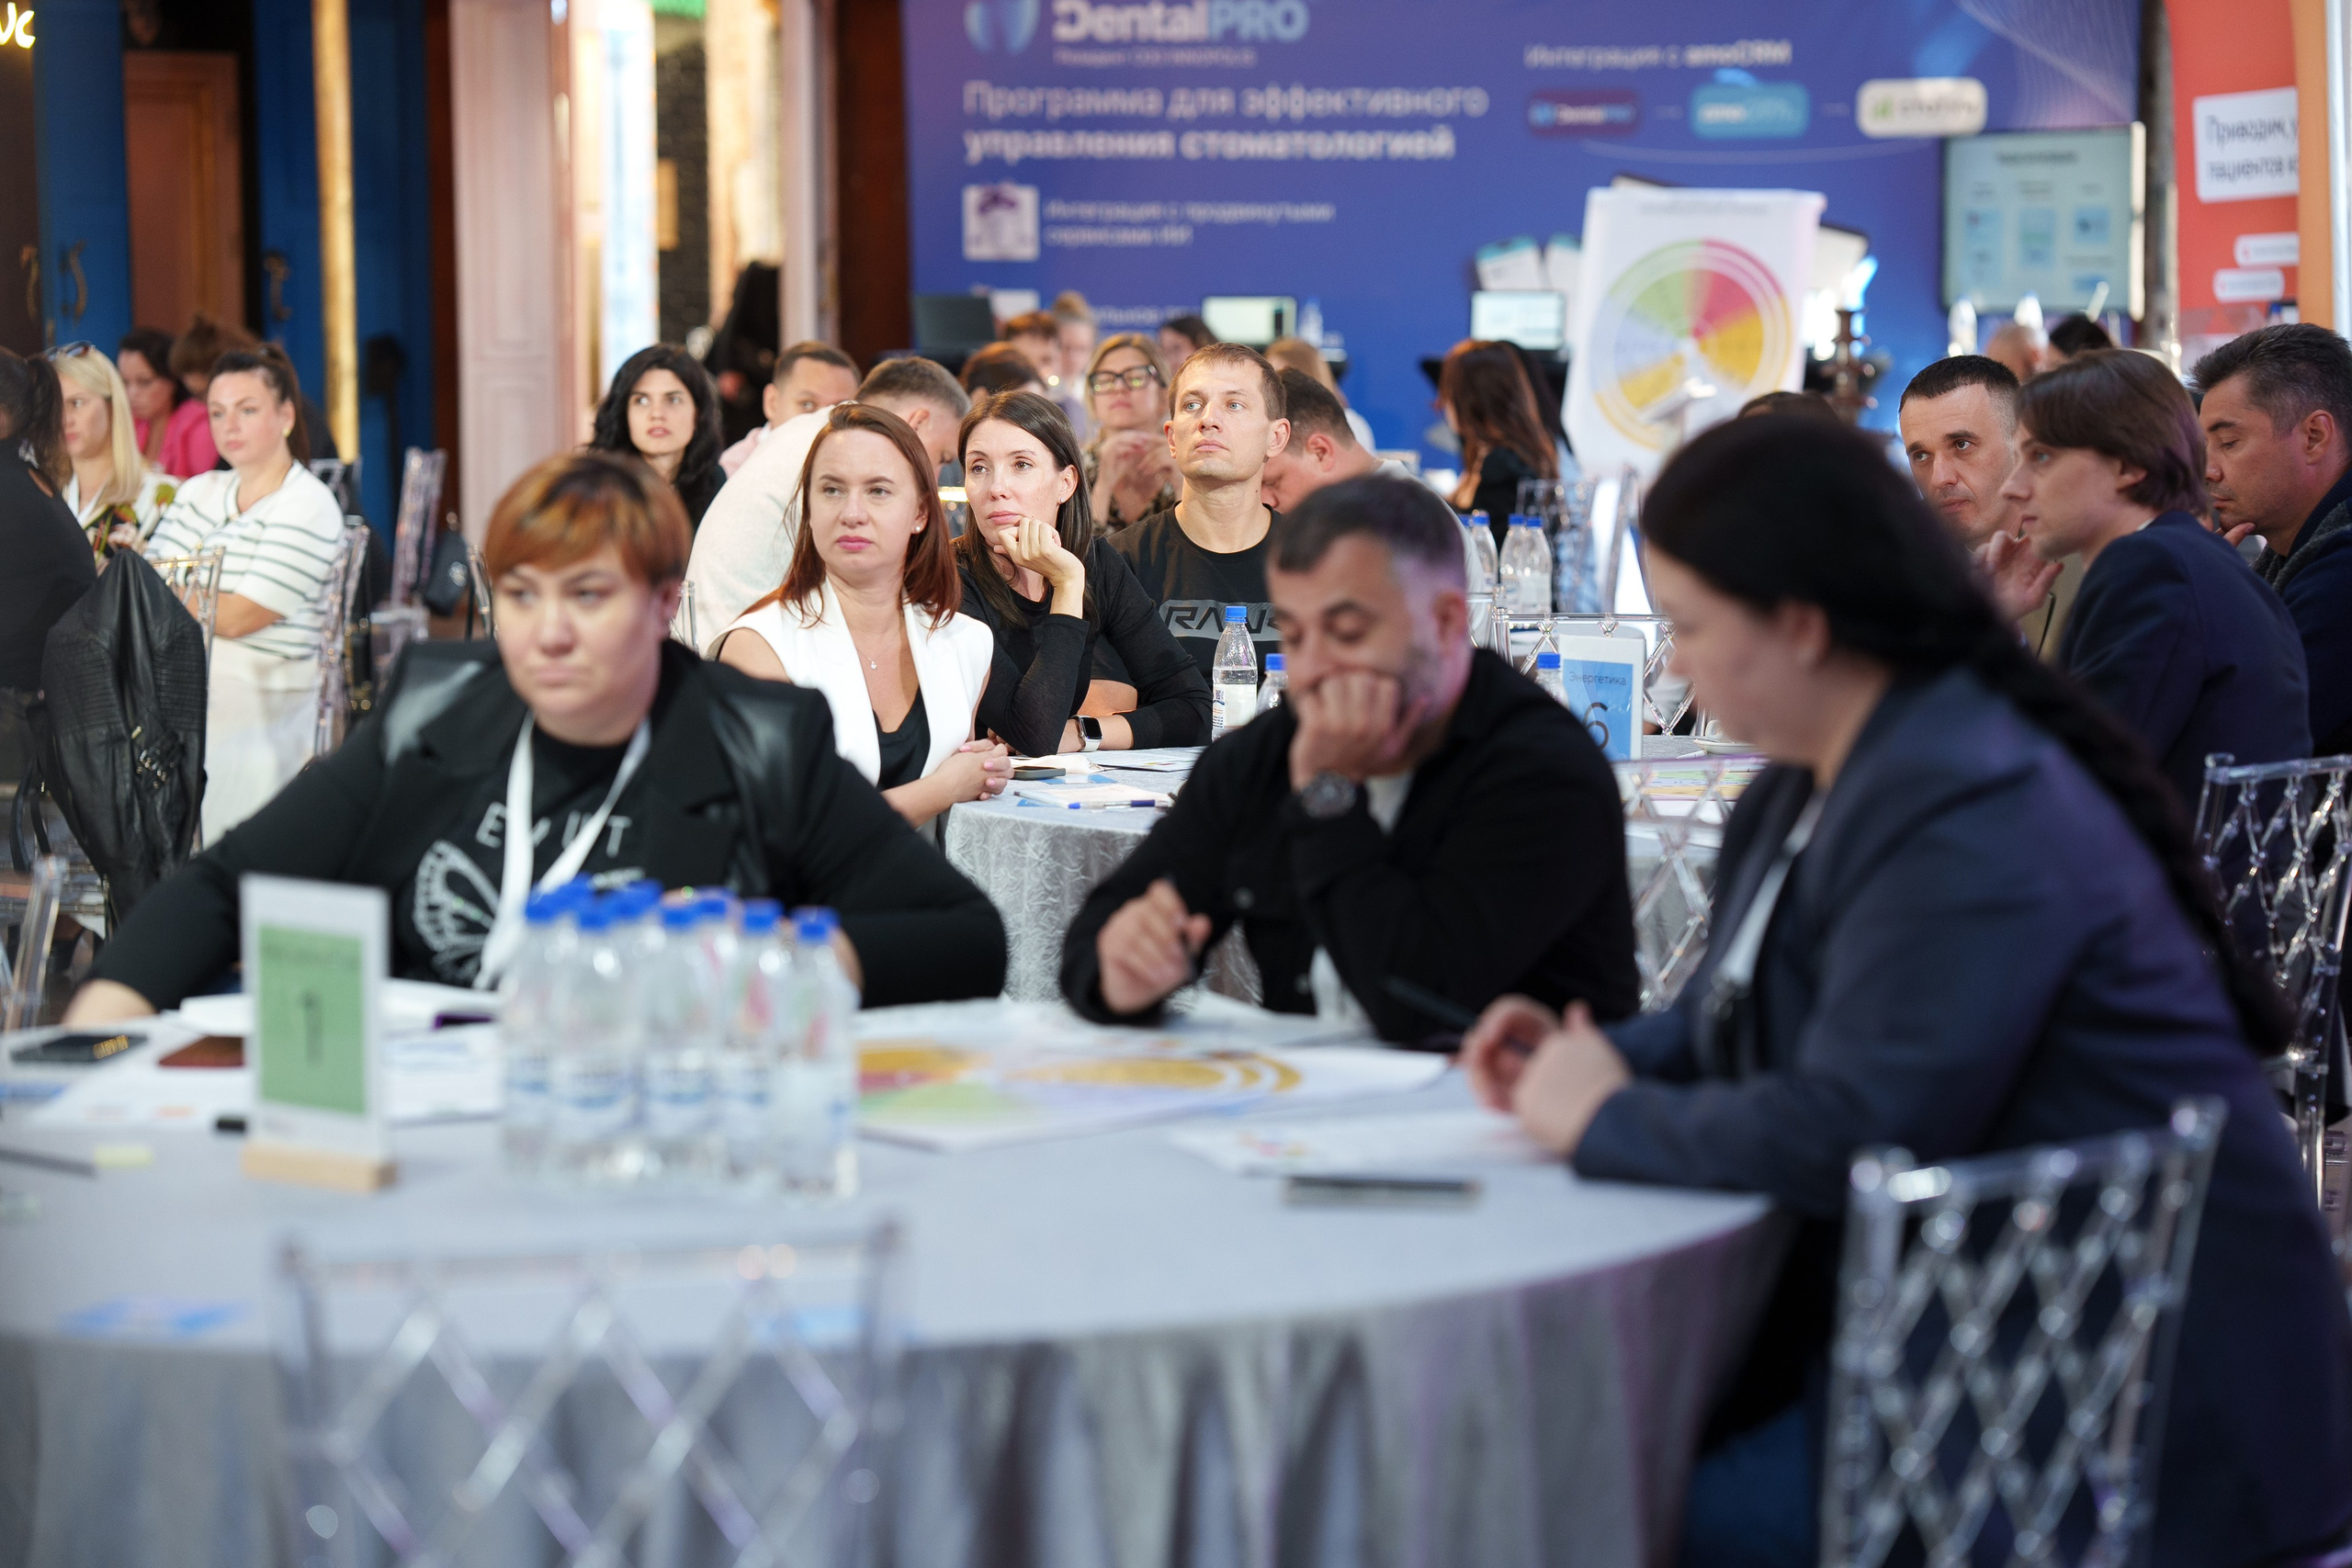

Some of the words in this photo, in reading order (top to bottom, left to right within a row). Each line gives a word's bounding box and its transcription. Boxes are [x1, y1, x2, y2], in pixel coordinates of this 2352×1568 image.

[964, 80, 1163, 121] Программа
[1166, 87, 1235, 121] для
[1241, 81, 1488, 123] эффективного
[965, 130, 1175, 165] управления
[1180, 123, 1455, 160] стоматологией
[1569, 671, 1627, 686] Энергетика
[1582, 702, 1609, 750] 6
